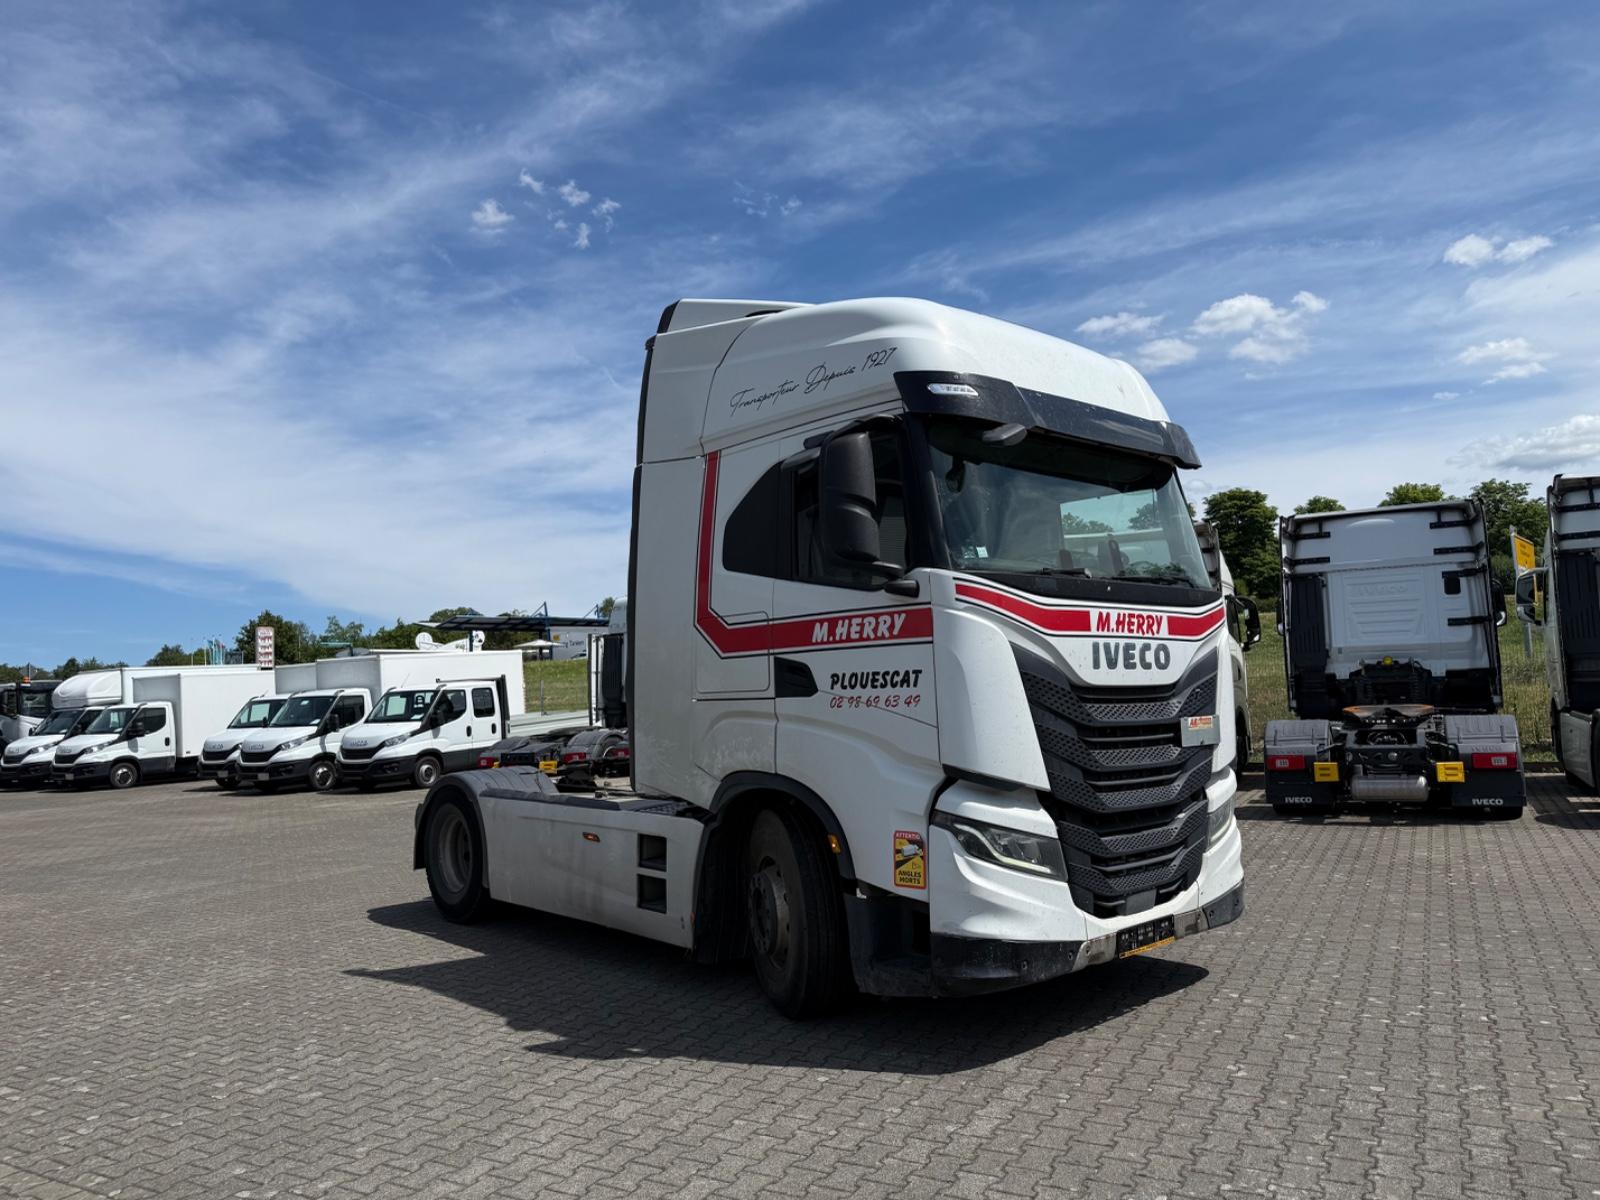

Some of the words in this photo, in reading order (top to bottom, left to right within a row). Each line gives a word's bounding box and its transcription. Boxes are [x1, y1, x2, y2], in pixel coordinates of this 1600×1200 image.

[730, 379, 799, 417] Transporteur
[804, 361, 857, 394] Depuis
[861, 347, 898, 371] 1927
[812, 613, 906, 643] M.HERRY
[1096, 611, 1163, 636] M.HERRY
[1092, 641, 1171, 670] IVECO
[830, 669, 922, 690] PLOUESCAT
[829, 697, 843, 709] 02
[904, 694, 921, 707] 49
[1285, 796, 1313, 804] IVECO
[1471, 798, 1504, 806] IVECO
